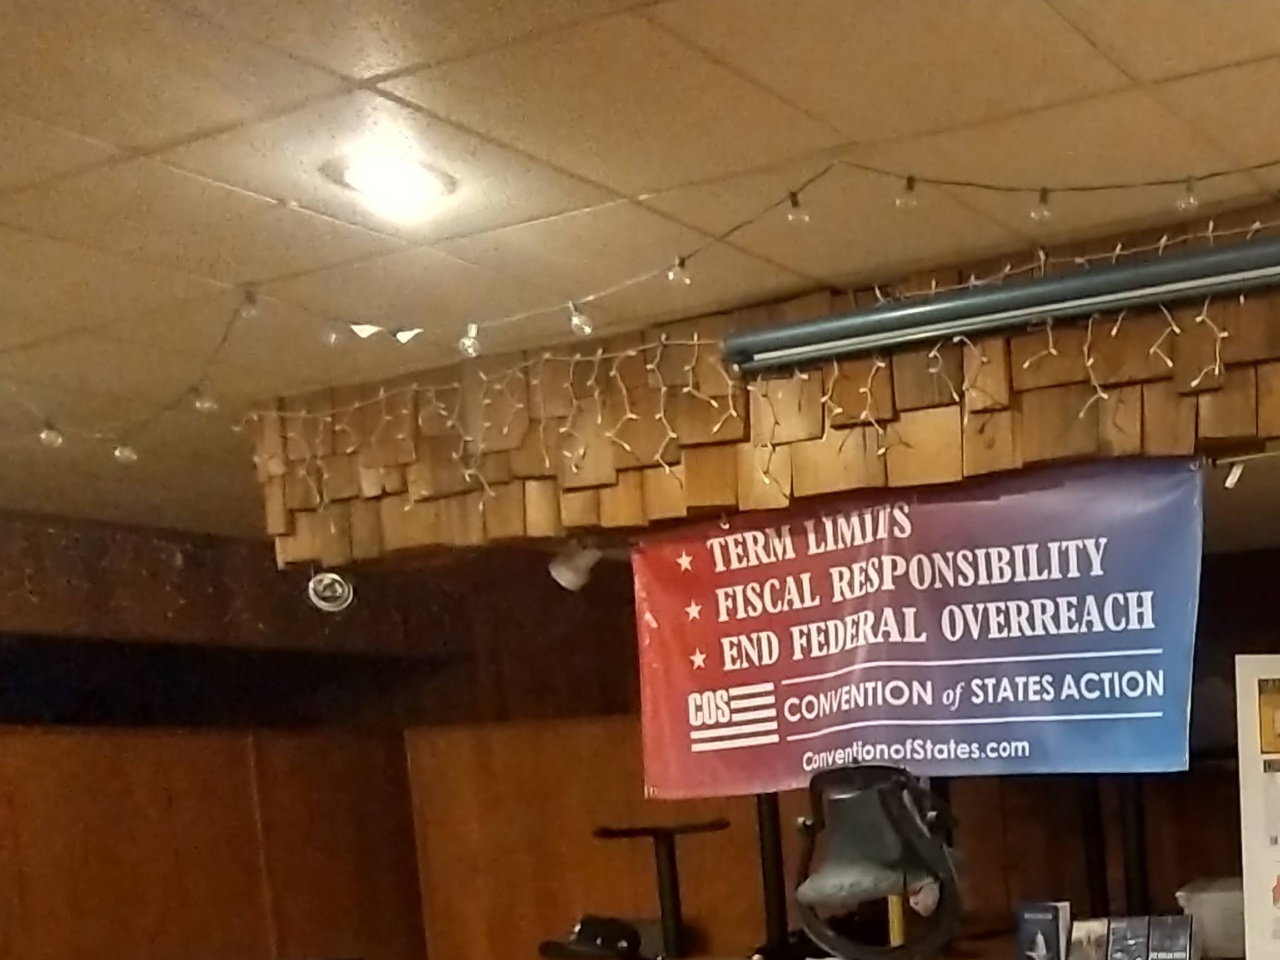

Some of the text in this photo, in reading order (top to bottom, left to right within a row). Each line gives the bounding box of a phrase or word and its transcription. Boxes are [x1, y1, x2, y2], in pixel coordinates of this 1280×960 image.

[707, 503, 912, 574] TERM LIMITS
[715, 537, 1109, 623] FISCAL RESPONSIBILITY
[721, 591, 1156, 672] END FEDERAL OVERREACH
[688, 689, 731, 727] COS
[784, 669, 1164, 723] CONVENTION of STATES ACTION
[802, 738, 1031, 773] ConventionofStates.com
